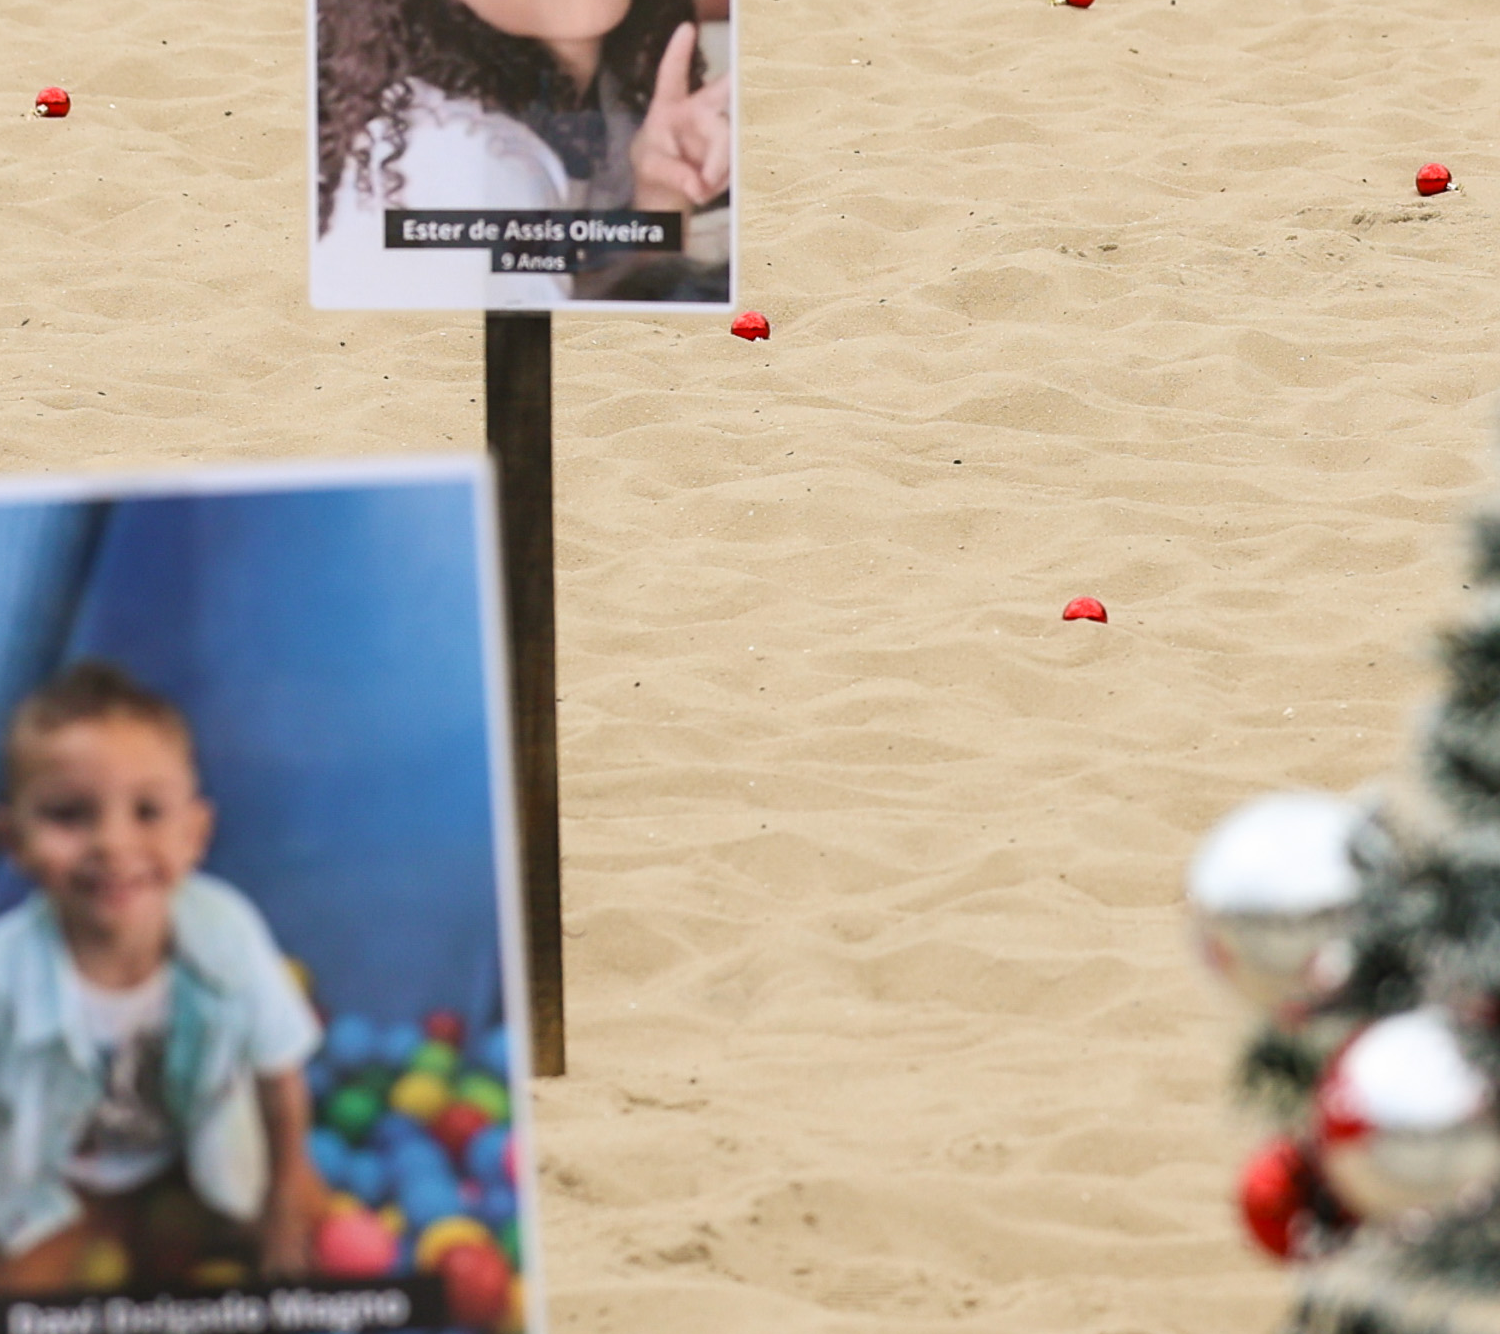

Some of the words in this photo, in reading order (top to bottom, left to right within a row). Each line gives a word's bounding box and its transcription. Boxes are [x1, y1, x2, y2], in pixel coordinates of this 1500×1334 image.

[402, 218, 465, 241] Ester
[468, 218, 500, 241] de
[503, 219, 566, 242] Assis
[568, 220, 664, 244] Oliveira
[500, 252, 513, 271] 9
[516, 253, 566, 271] Anos
